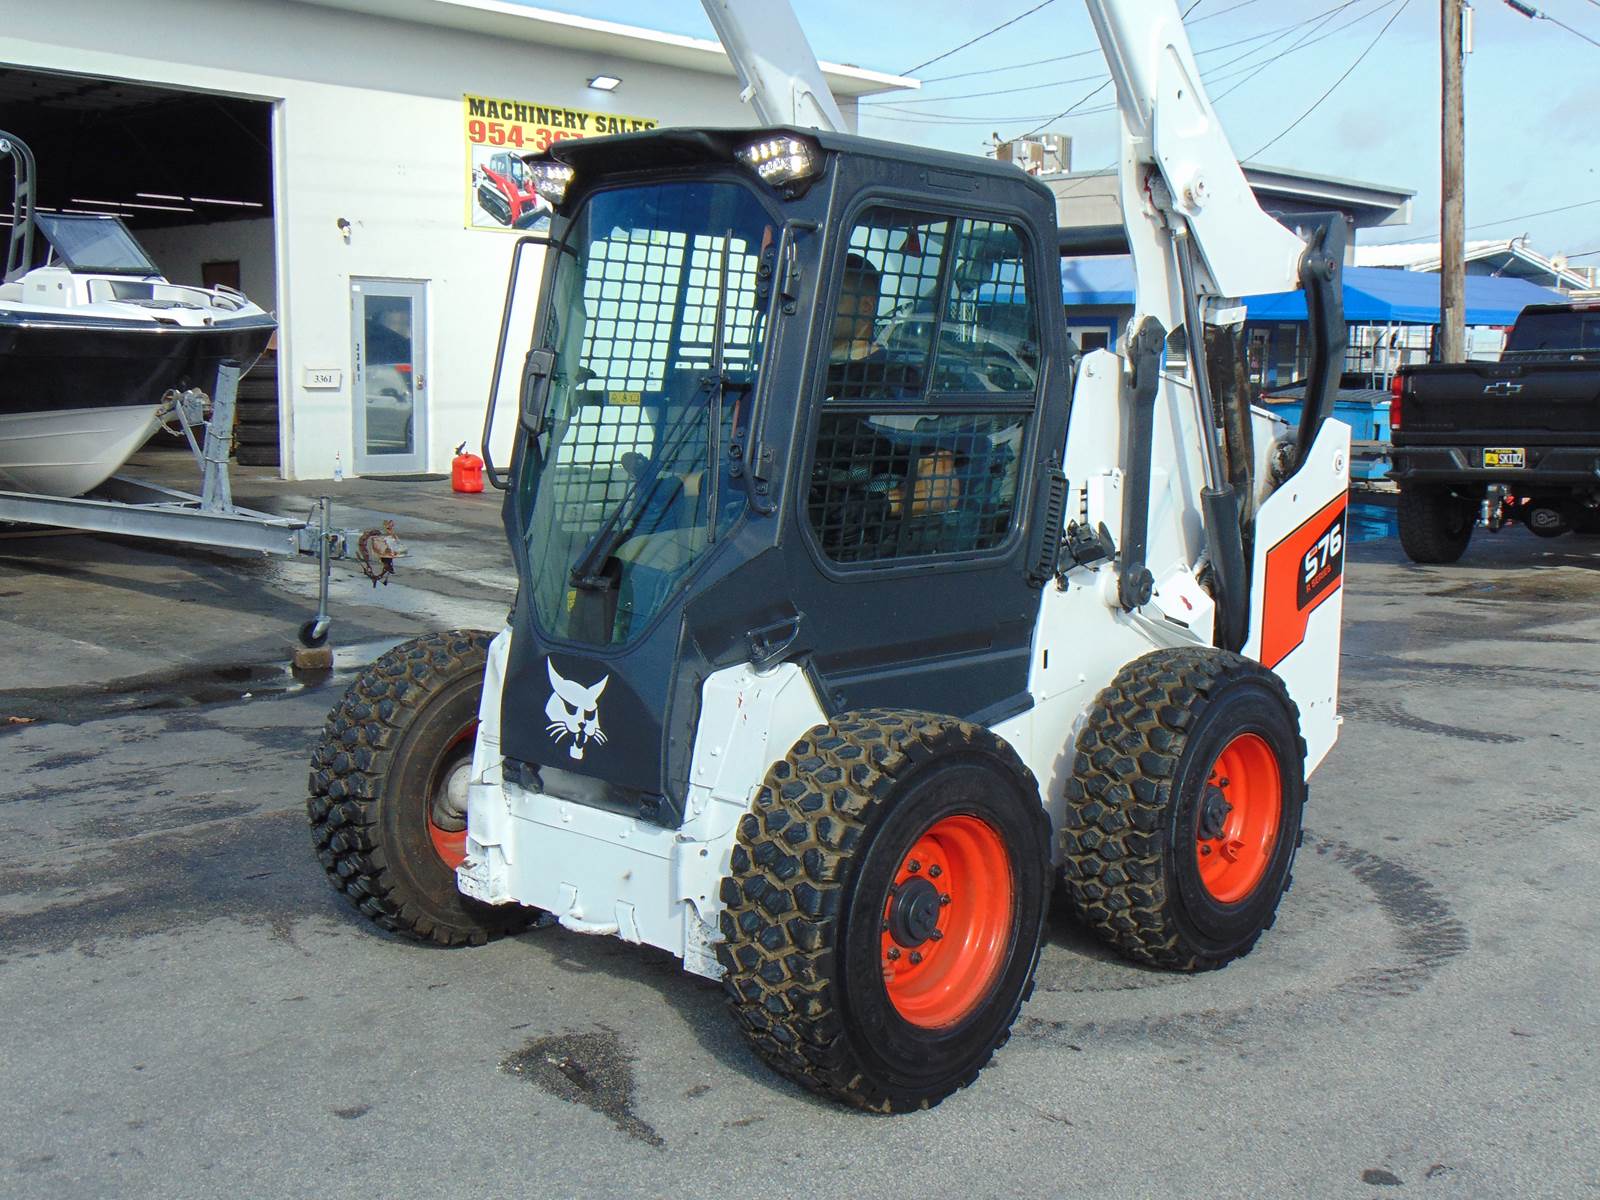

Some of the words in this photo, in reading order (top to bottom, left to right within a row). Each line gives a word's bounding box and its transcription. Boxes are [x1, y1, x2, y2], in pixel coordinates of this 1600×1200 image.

[468, 98, 589, 130] MACHINERY
[314, 375, 332, 383] 3361
[1304, 523, 1342, 583] S76
